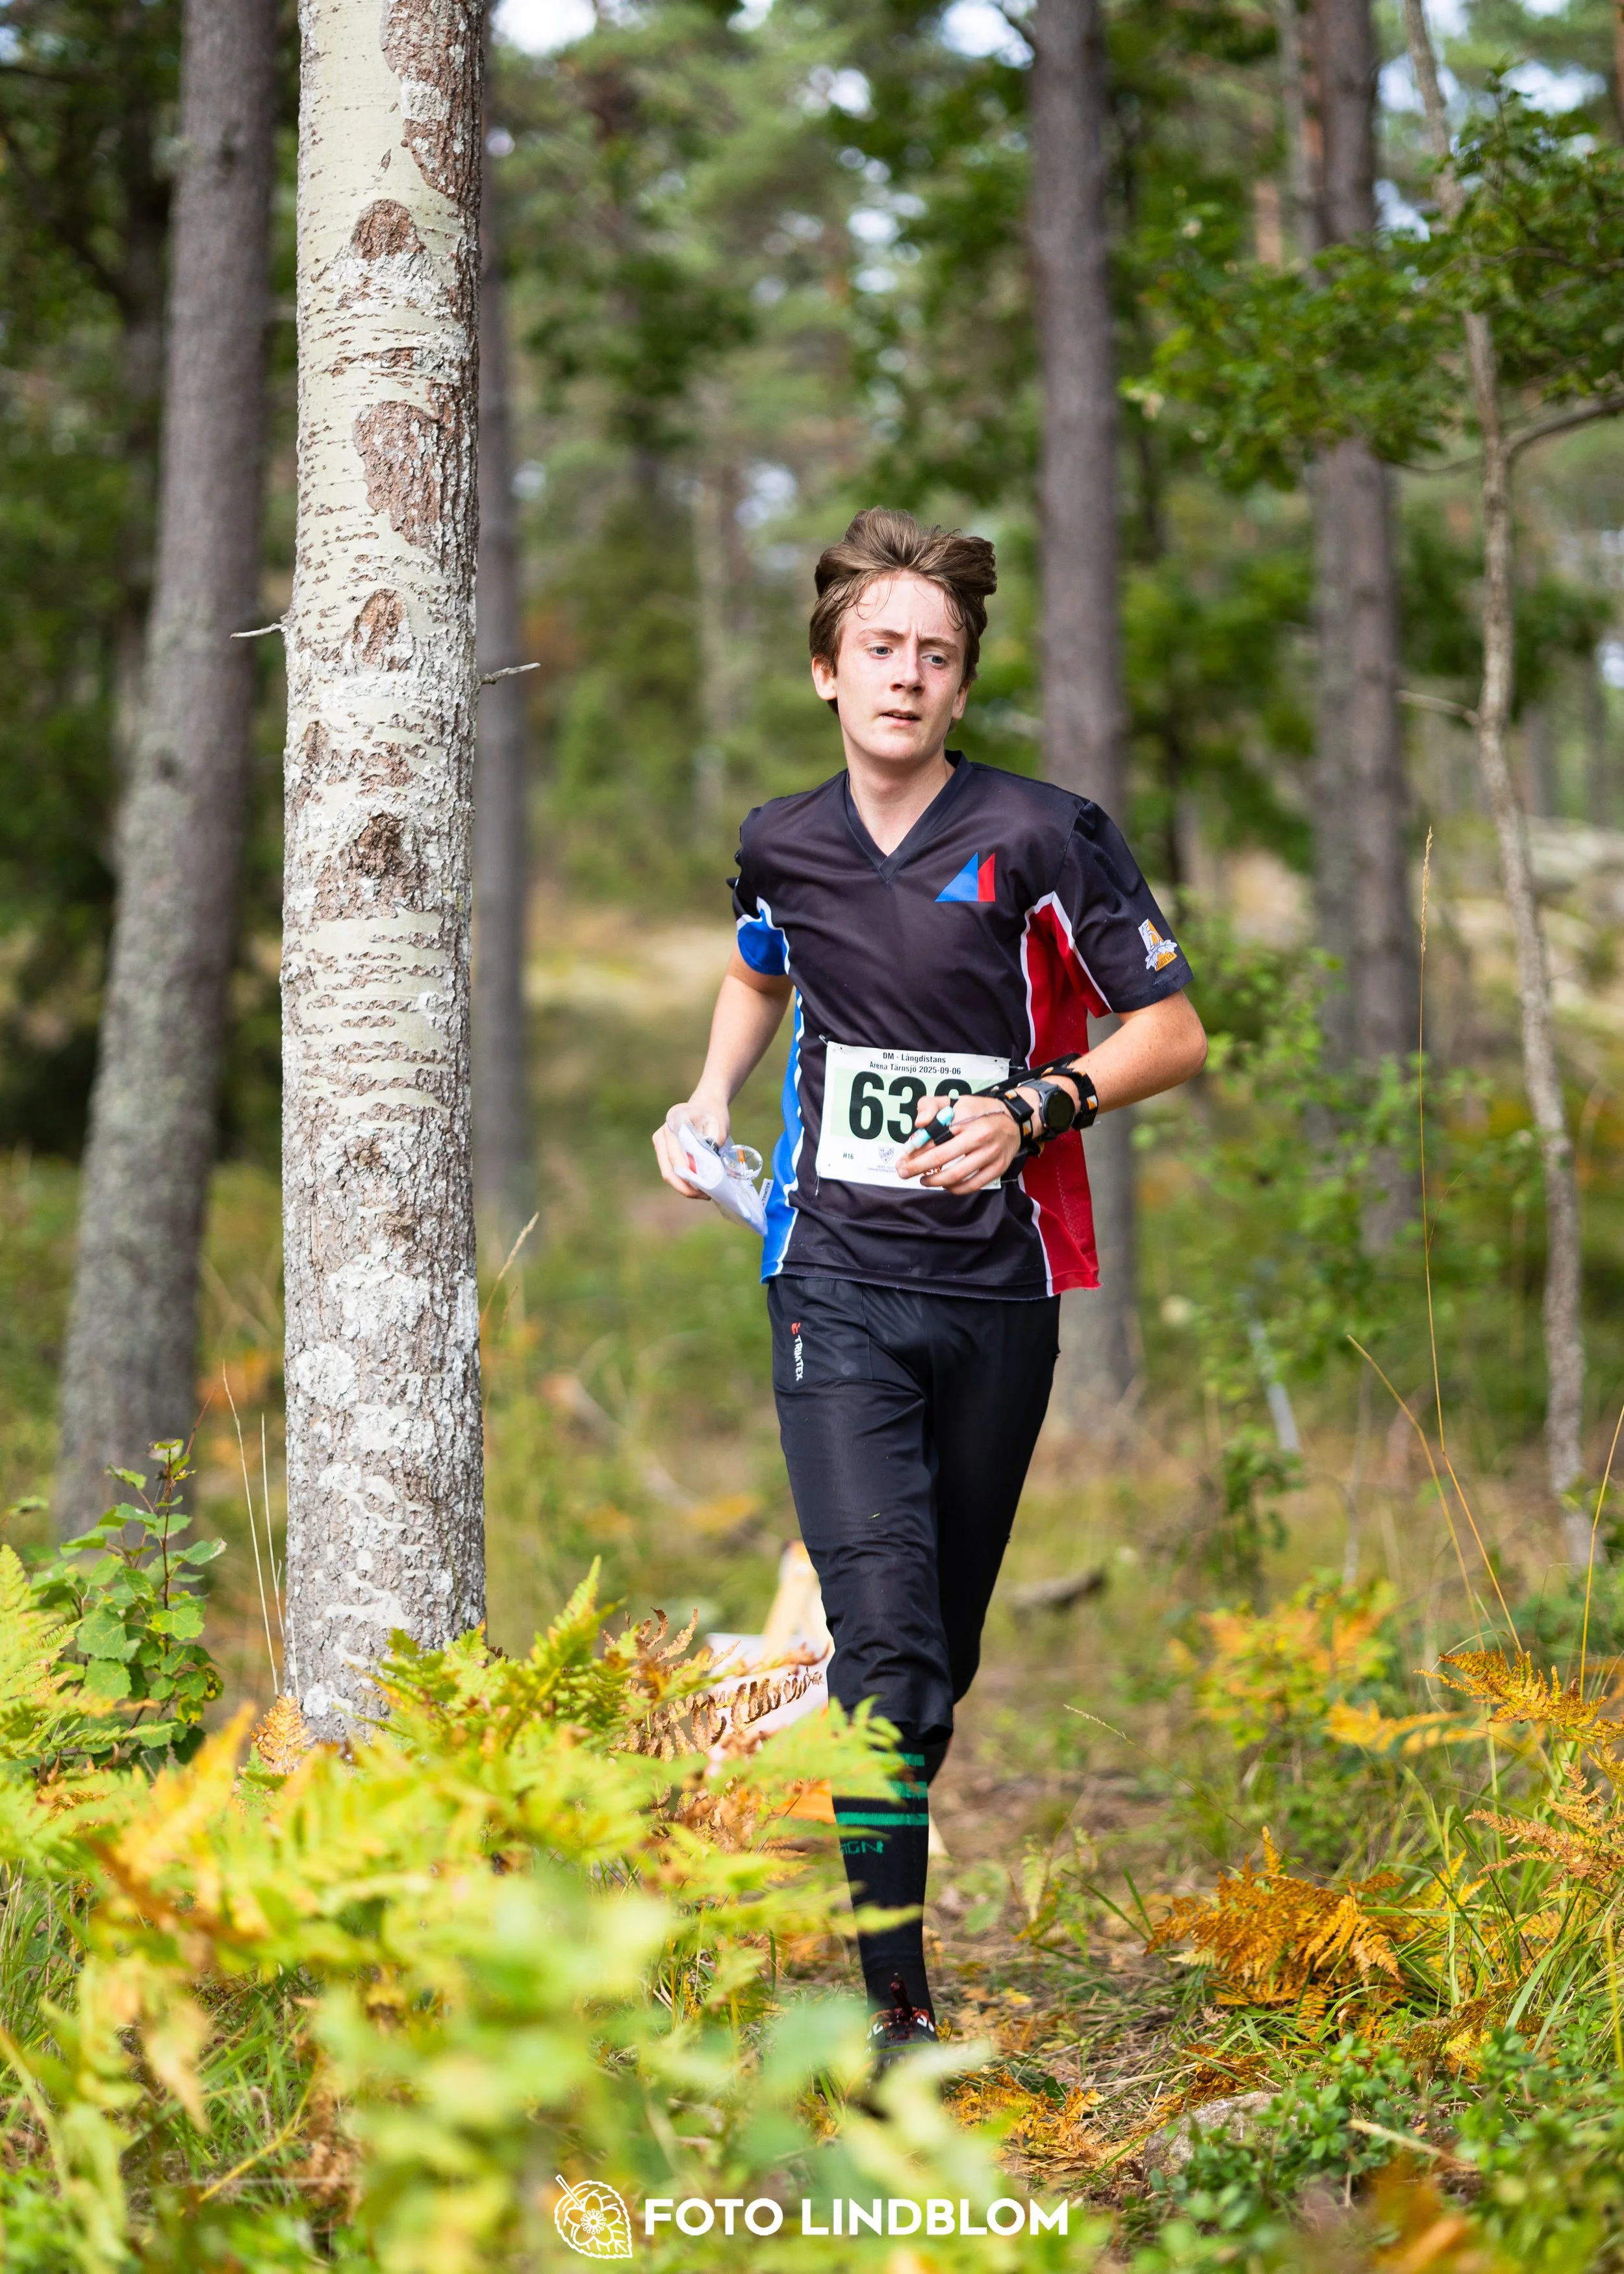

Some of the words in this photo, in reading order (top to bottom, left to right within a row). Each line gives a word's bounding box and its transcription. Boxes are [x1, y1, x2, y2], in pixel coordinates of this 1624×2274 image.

[901, 1053, 946, 1064] Långdistans
[869, 1061, 888, 1070] Arena
[891, 1063, 917, 1073] Tärnsjö
[919, 1066, 961, 1075] 2025-09-06
[794, 1334, 804, 1381] TRIMTEX
